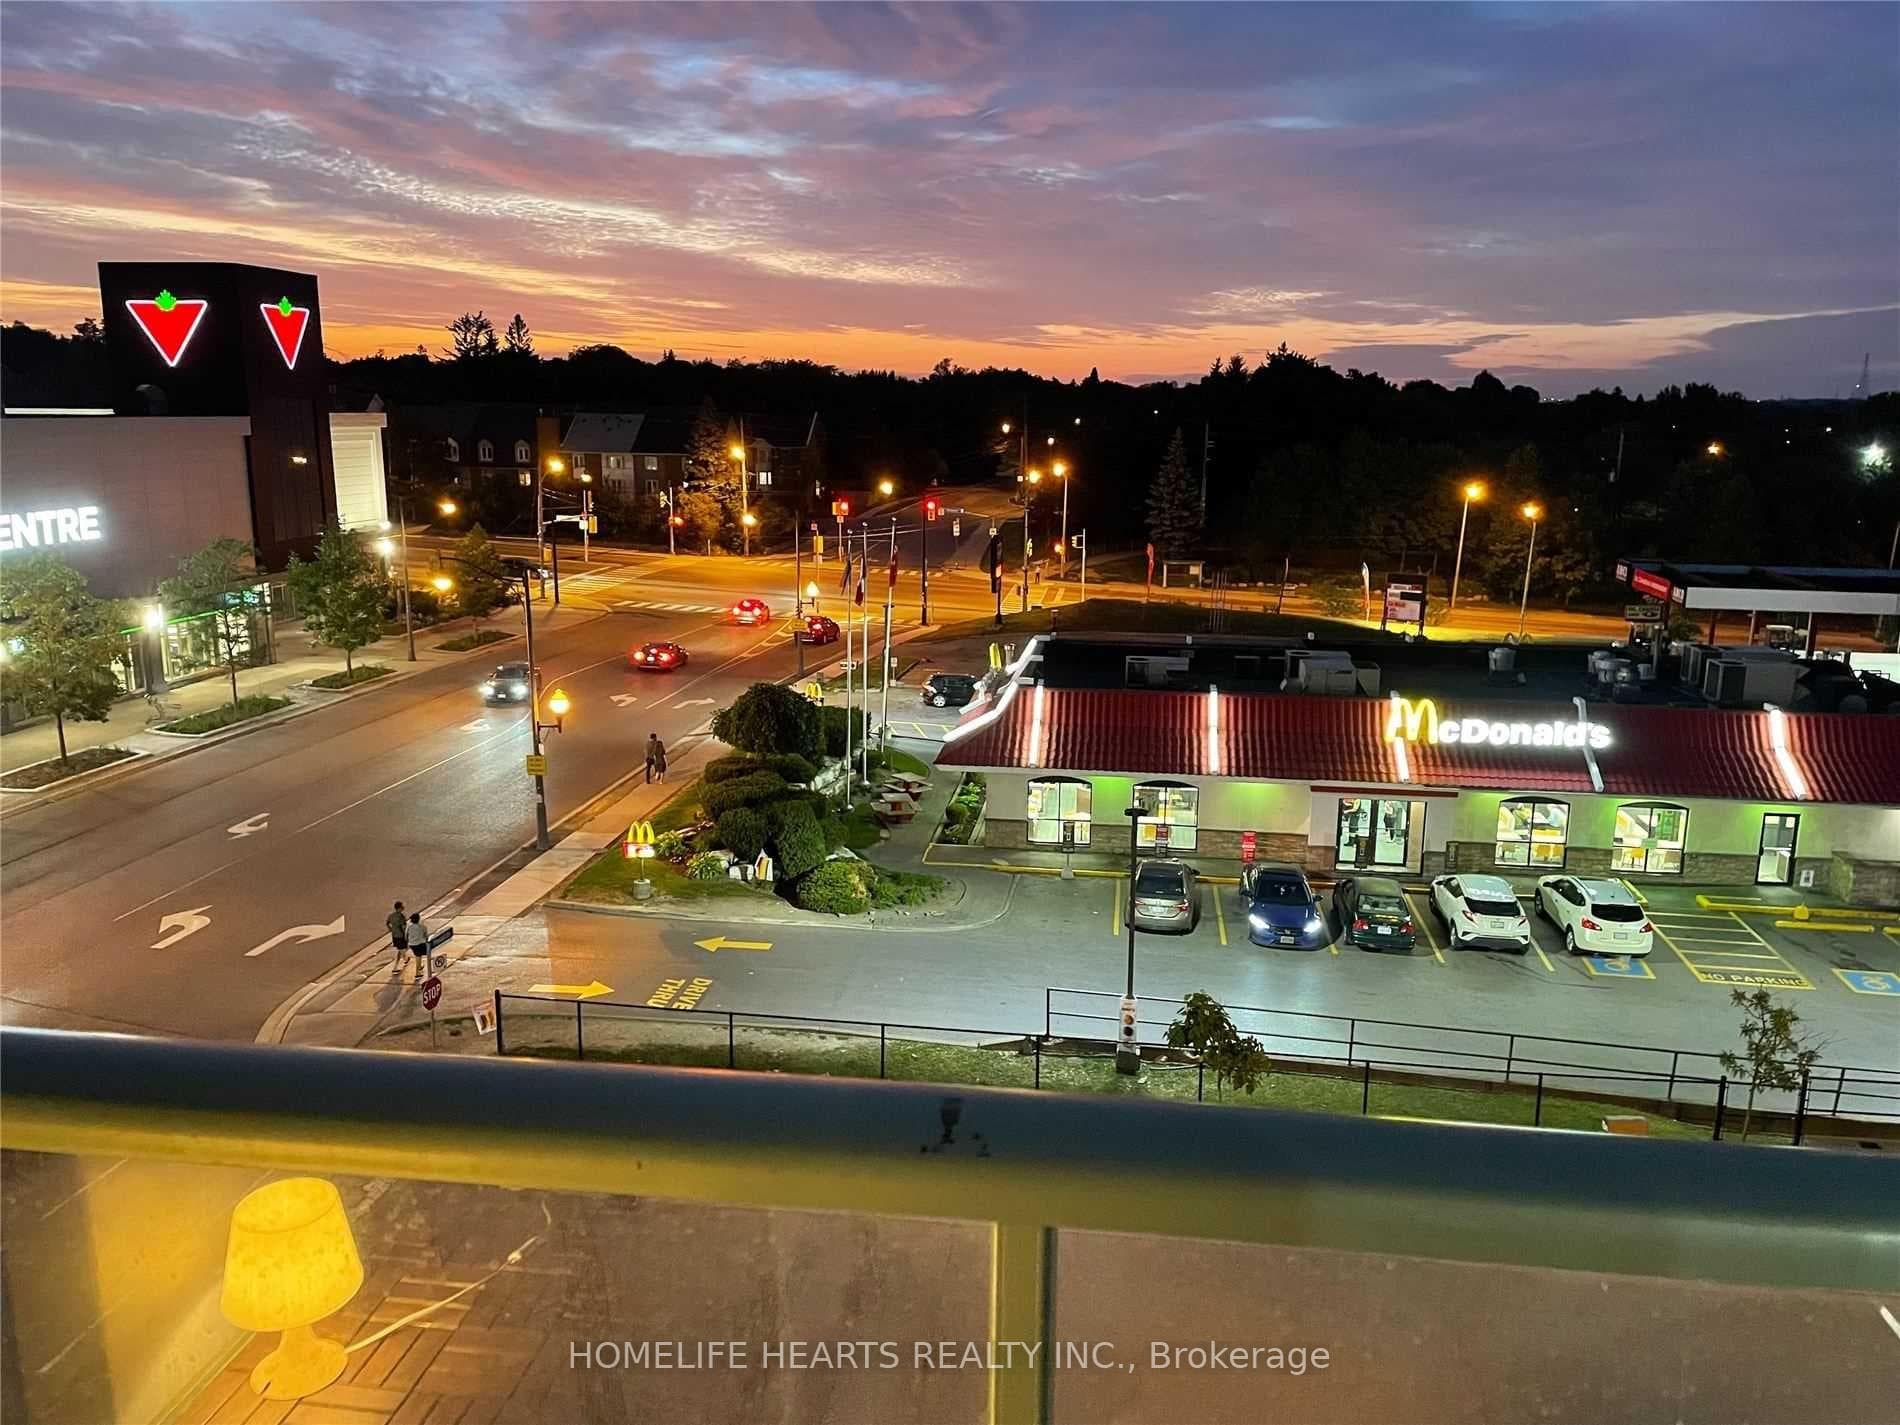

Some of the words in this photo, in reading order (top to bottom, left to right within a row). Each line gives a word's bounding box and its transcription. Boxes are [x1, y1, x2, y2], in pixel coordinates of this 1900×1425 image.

[1385, 697, 1613, 749] McDonald's
[1700, 972, 1725, 981] NO
[1730, 974, 1809, 987] PARKING
[423, 983, 441, 1005] STOP
[646, 979, 686, 1008] THRU
